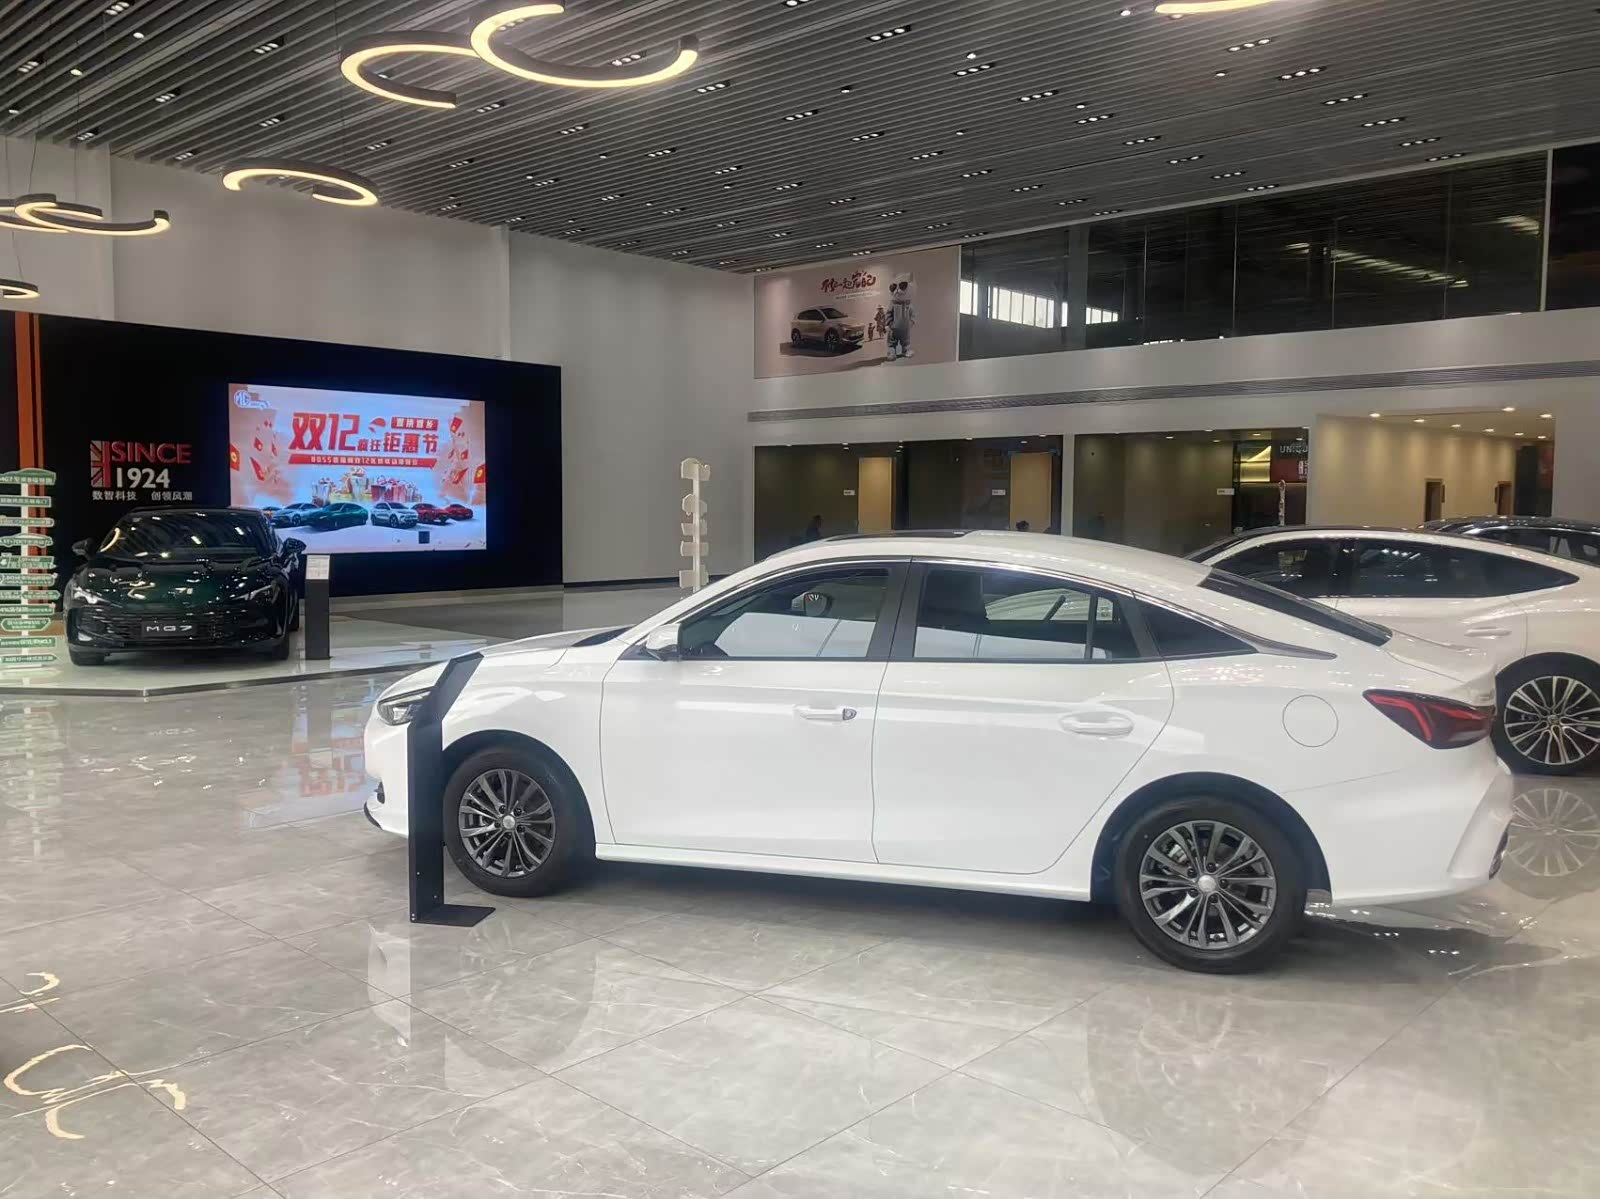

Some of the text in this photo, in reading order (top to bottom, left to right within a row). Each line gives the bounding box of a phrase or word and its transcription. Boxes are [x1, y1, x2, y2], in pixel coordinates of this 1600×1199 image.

[111, 440, 193, 464] SINCE
[116, 467, 171, 488] 1924
[92, 490, 137, 501] 数智科技
